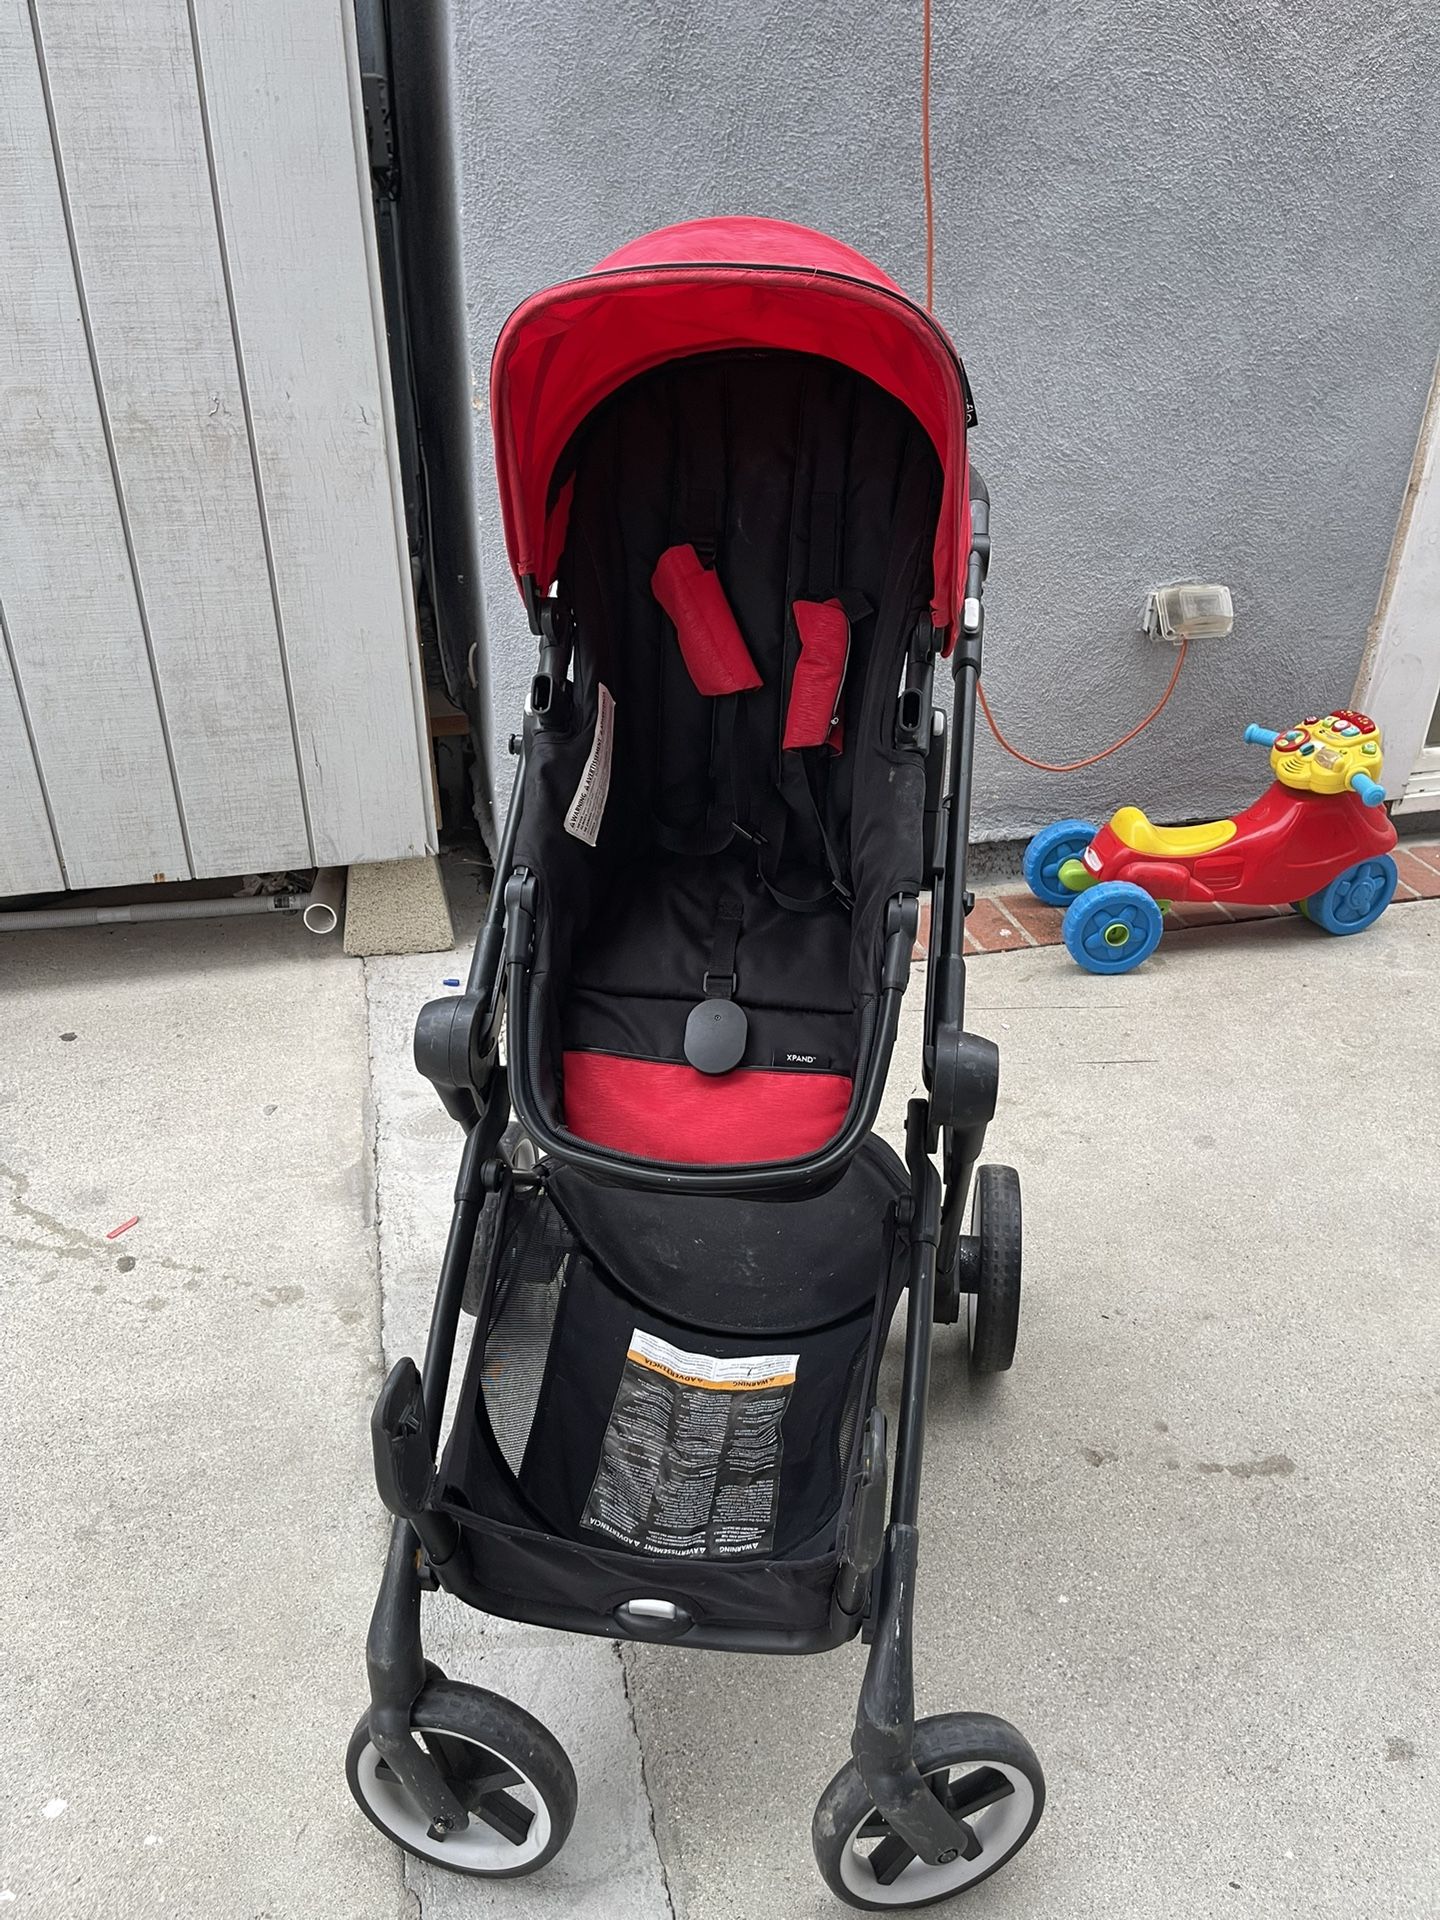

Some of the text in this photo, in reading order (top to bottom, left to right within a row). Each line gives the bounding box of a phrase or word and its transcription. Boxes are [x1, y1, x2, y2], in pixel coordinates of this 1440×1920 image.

[570, 793, 586, 822] WARNING
[644, 1357, 699, 1383] ADVERTENCIA
[732, 1380, 769, 1388] WARNING
[589, 1517, 634, 1545] ADVERTENCIA
[643, 1543, 699, 1556] AVERTISSEMENT
[719, 1543, 753, 1553] WARNING
